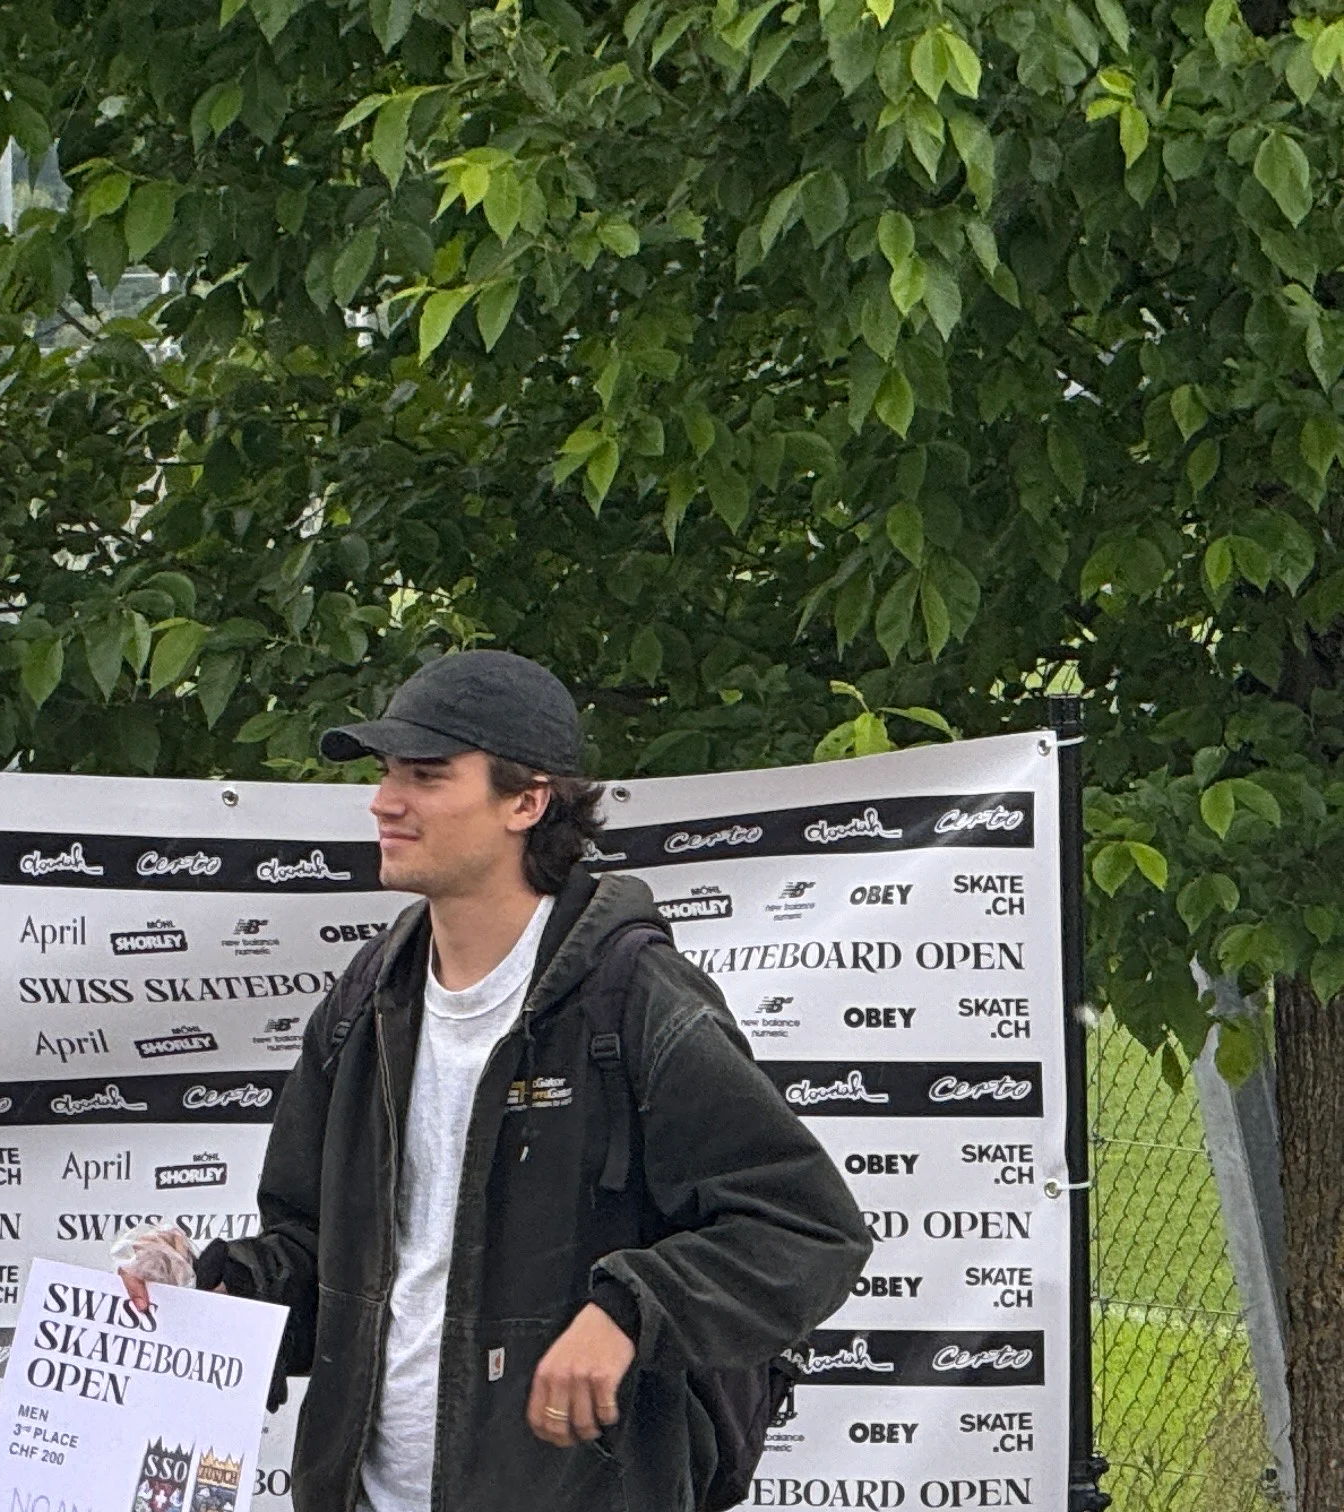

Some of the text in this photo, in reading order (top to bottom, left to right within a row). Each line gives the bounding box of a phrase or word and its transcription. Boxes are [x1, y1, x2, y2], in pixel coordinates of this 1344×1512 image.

[934, 806, 1024, 834] Certo
[664, 825, 763, 854] Certo
[849, 884, 914, 905] OBEY
[953, 875, 1024, 894] SKATE
[984, 897, 1025, 916] .CH
[19, 915, 87, 953] April
[115, 934, 184, 952] SHORLEY
[680, 941, 1025, 974] SKATEBOARD OPEN
[19, 976, 135, 1004] SWISS
[844, 1007, 916, 1029] OBEY
[958, 998, 1030, 1017] SKATE
[990, 1019, 1031, 1039] .CH
[35, 1028, 110, 1063] April
[182, 1083, 273, 1110] Certo
[844, 1153, 920, 1175] OBEY
[961, 1144, 1034, 1164] SKATE
[62, 1150, 132, 1190] April
[159, 1167, 224, 1185] SHORLEY
[993, 1166, 1034, 1185] .CH
[923, 1211, 1033, 1240] OPEN
[965, 1267, 1033, 1287] SKATE
[43, 1282, 158, 1333] SWISS
[992, 1289, 1033, 1308] .CH
[34, 1320, 244, 1391] SKATEBOARD
[932, 1345, 1033, 1372] Certo
[27, 1357, 131, 1405] OPEN
[17, 1404, 49, 1421] MEN
[959, 1412, 1033, 1432] SKATE
[33, 1427, 79, 1448] PLACE
[848, 1423, 919, 1444] OBEY
[993, 1434, 1034, 1452] .CH
[9, 1442, 65, 1466] CHF 200
[144, 1453, 188, 1483] SSO
[754, 1477, 1033, 1512] EBOARD OPEN
